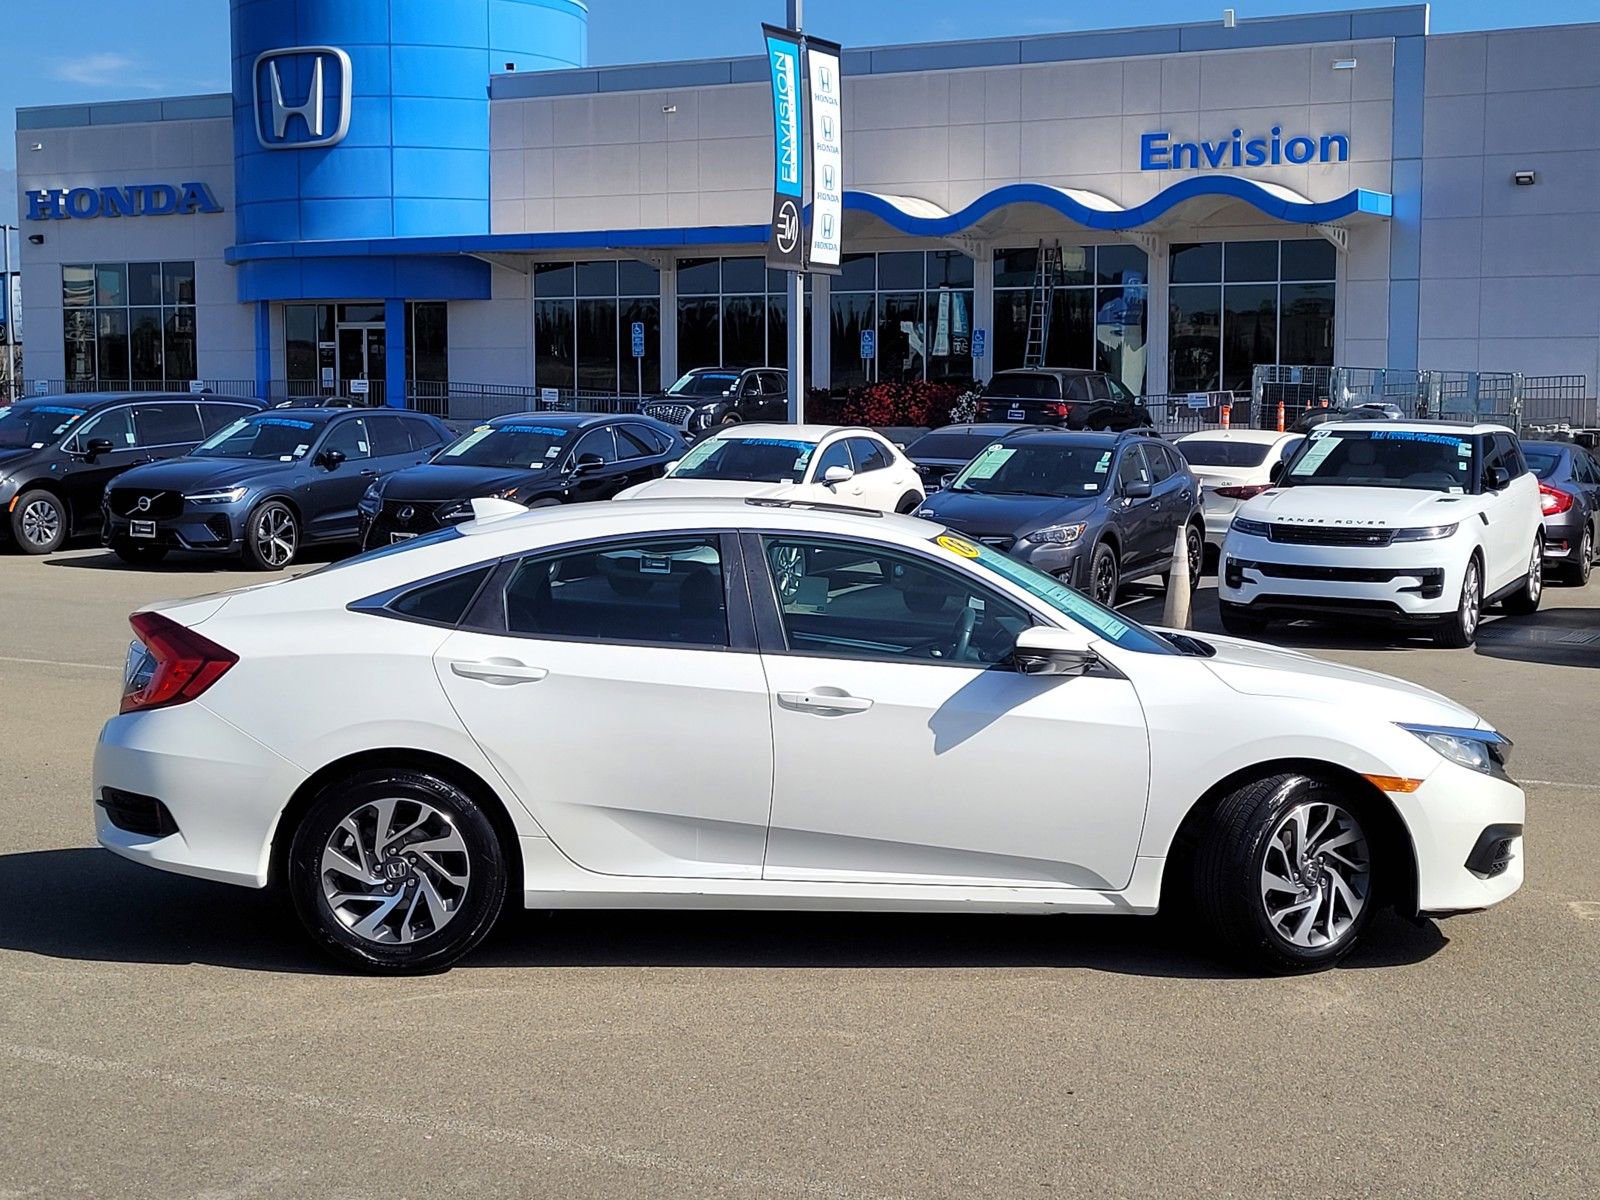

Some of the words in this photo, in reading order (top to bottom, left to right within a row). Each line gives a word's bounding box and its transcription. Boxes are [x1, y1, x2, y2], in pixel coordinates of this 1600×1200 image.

[815, 93, 838, 106] HONDA
[774, 51, 793, 182] ENVISION
[816, 142, 840, 154] HONDA
[1140, 126, 1349, 171] Envision
[25, 182, 224, 220] HONDA
[817, 192, 840, 203] HONDA
[814, 241, 838, 252] HONDA
